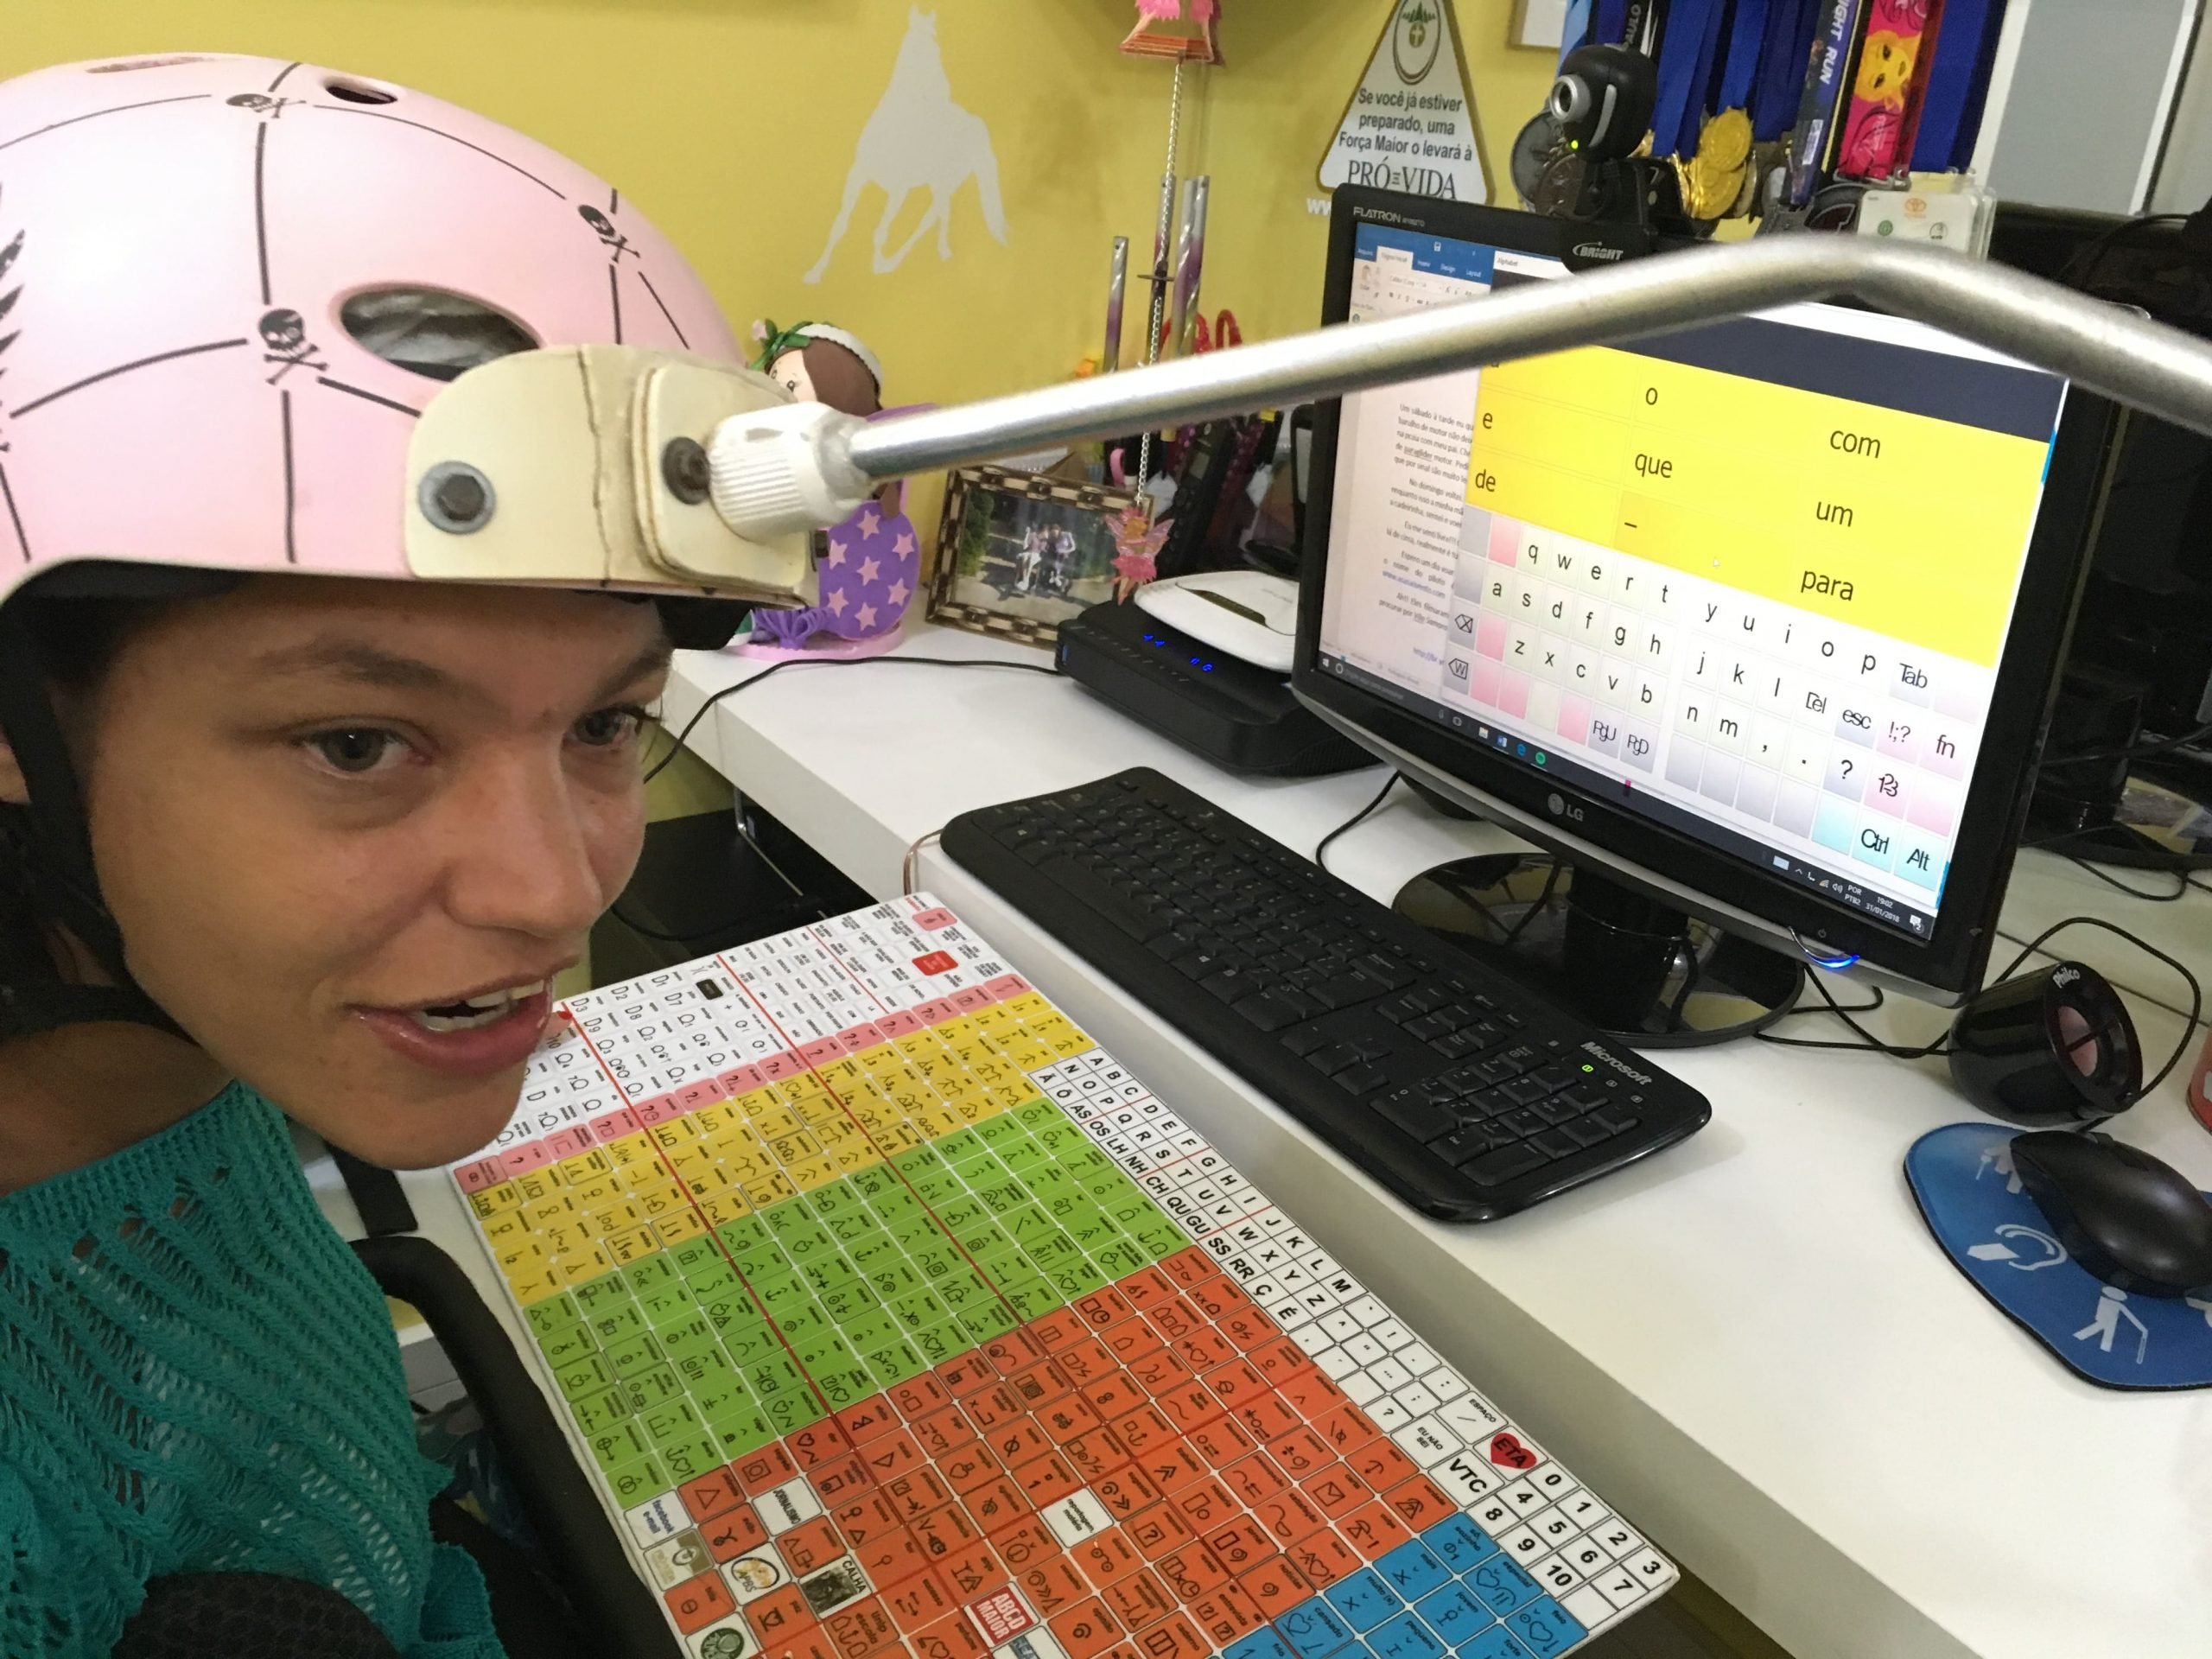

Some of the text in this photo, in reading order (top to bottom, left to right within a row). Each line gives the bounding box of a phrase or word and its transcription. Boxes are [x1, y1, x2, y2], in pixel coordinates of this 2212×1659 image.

[1820, 47, 1838, 85] RUN
[1358, 87, 1462, 112] Se você já estiver
[1359, 113, 1455, 136] preparado, uma
[1339, 130, 1372, 152] Força
[1375, 135, 1408, 153] Maior
[1411, 141, 1420, 153] o
[1423, 139, 1461, 160] levará
[1353, 207, 1401, 223] FLATRON
[1440, 263, 1482, 278] Design Layout
[1645, 387, 1880, 458] o com
[1483, 413, 1853, 527] e que um
[1475, 469, 1853, 601] de para
[1529, 544, 1928, 689] q w e r t y u i o p Tab
[1492, 582, 1502, 597] a
[1522, 593, 1531, 607] s
[1552, 601, 1562, 619] d
[1586, 612, 1593, 629] f
[1614, 626, 1626, 646] g
[1650, 634, 1661, 655] h
[1696, 652, 1706, 675] j
[1733, 664, 1744, 684] k
[1842, 709, 1872, 729] esc
[1936, 734, 1955, 759] fn
[1515, 640, 1525, 655] z
[1545, 652, 1554, 667] x
[1576, 664, 1586, 678] c
[1608, 676, 1618, 690] v
[1641, 684, 1652, 703] b
[1687, 706, 1698, 722] n
[1719, 719, 1738, 738] m
[1841, 760, 1853, 779] ?
[1592, 721, 1929, 871] PgU PgD Ctrl Alt
[1567, 804, 1584, 823] LG
[1847, 884, 1862, 896] POR
[2053, 967, 2081, 988] Philco
[1581, 1041, 1652, 1086] Microsoft
[1065, 1065, 1079, 1073] N
[1083, 1080, 1096, 1089] O
[1118, 1114, 1132, 1124] Q
[1135, 1131, 1151, 1141] R
[1155, 1149, 1170, 1159] S
[1178, 1168, 1192, 1178] T
[1198, 1189, 1215, 1199] U
[1216, 1205, 1232, 1215] V
[1238, 1227, 1258, 1241] W
[1261, 1249, 1279, 1262] X
[1284, 1269, 1300, 1281] Y
[1306, 1294, 1325, 1307] Z
[1090, 1058, 1103, 1066] A
[1106, 1071, 1121, 1080] B
[1124, 1087, 1138, 1096] C
[1143, 1104, 1158, 1114] D
[1161, 1121, 1177, 1130] E
[1201, 1157, 1217, 1167] G
[1220, 1175, 1237, 1185] H
[1286, 1236, 1304, 1249] K
[1310, 1259, 1323, 1270] L
[1332, 1279, 1351, 1293] M
[1070, 1105, 1092, 1119] AS
[1090, 1121, 1110, 1136] OS
[1106, 1138, 1128, 1154] LH
[1125, 1156, 1149, 1173] NH
[1146, 1177, 1169, 1194] CH
[1166, 1193, 1191, 1215] QU
[1185, 1216, 1211, 1234] GU
[1208, 1237, 1231, 1255] SS
[1229, 1258, 1255, 1280] RR
[1253, 1284, 1272, 1296] Ç
[1278, 1306, 1298, 1320] É
[1469, 1398, 1497, 1422] ESPAÇO
[1416, 1437, 1429, 1448] SEI
[1417, 1427, 1443, 1450] EU NÃO
[1493, 1438, 1527, 1468] ETA
[1450, 1458, 1487, 1493] VTC
[652, 1499, 674, 1534] facebook
[769, 1486, 801, 1524] JORNALISMO
[1064, 1509, 1083, 1531] matéria
[1067, 1498, 1094, 1532] reportagem,
[643, 1511, 661, 1534] e-mail
[1455, 1526, 1481, 1551] sozinho
[1545, 1474, 1661, 1574] 0 1 2 3
[1485, 1508, 1573, 1586] 8 9 10
[1516, 1493, 1633, 1591] 4 5 6 7
[842, 1560, 867, 1593] CALHA
[1367, 1576, 1386, 1595] muito
[1503, 1561, 1533, 1588] especial
[992, 1593, 1026, 1630] ABCD
[1218, 1593, 1248, 1626] entrevista
[1455, 1592, 1478, 1612] jovem
[1552, 1610, 1567, 1624] feio
[855, 1612, 878, 1644] escola
[976, 1600, 1009, 1638] MAIOR
[1314, 1607, 1343, 1638] cansado
[1405, 1620, 1435, 1650] pequeno
[1503, 1639, 1521, 1656] forte
